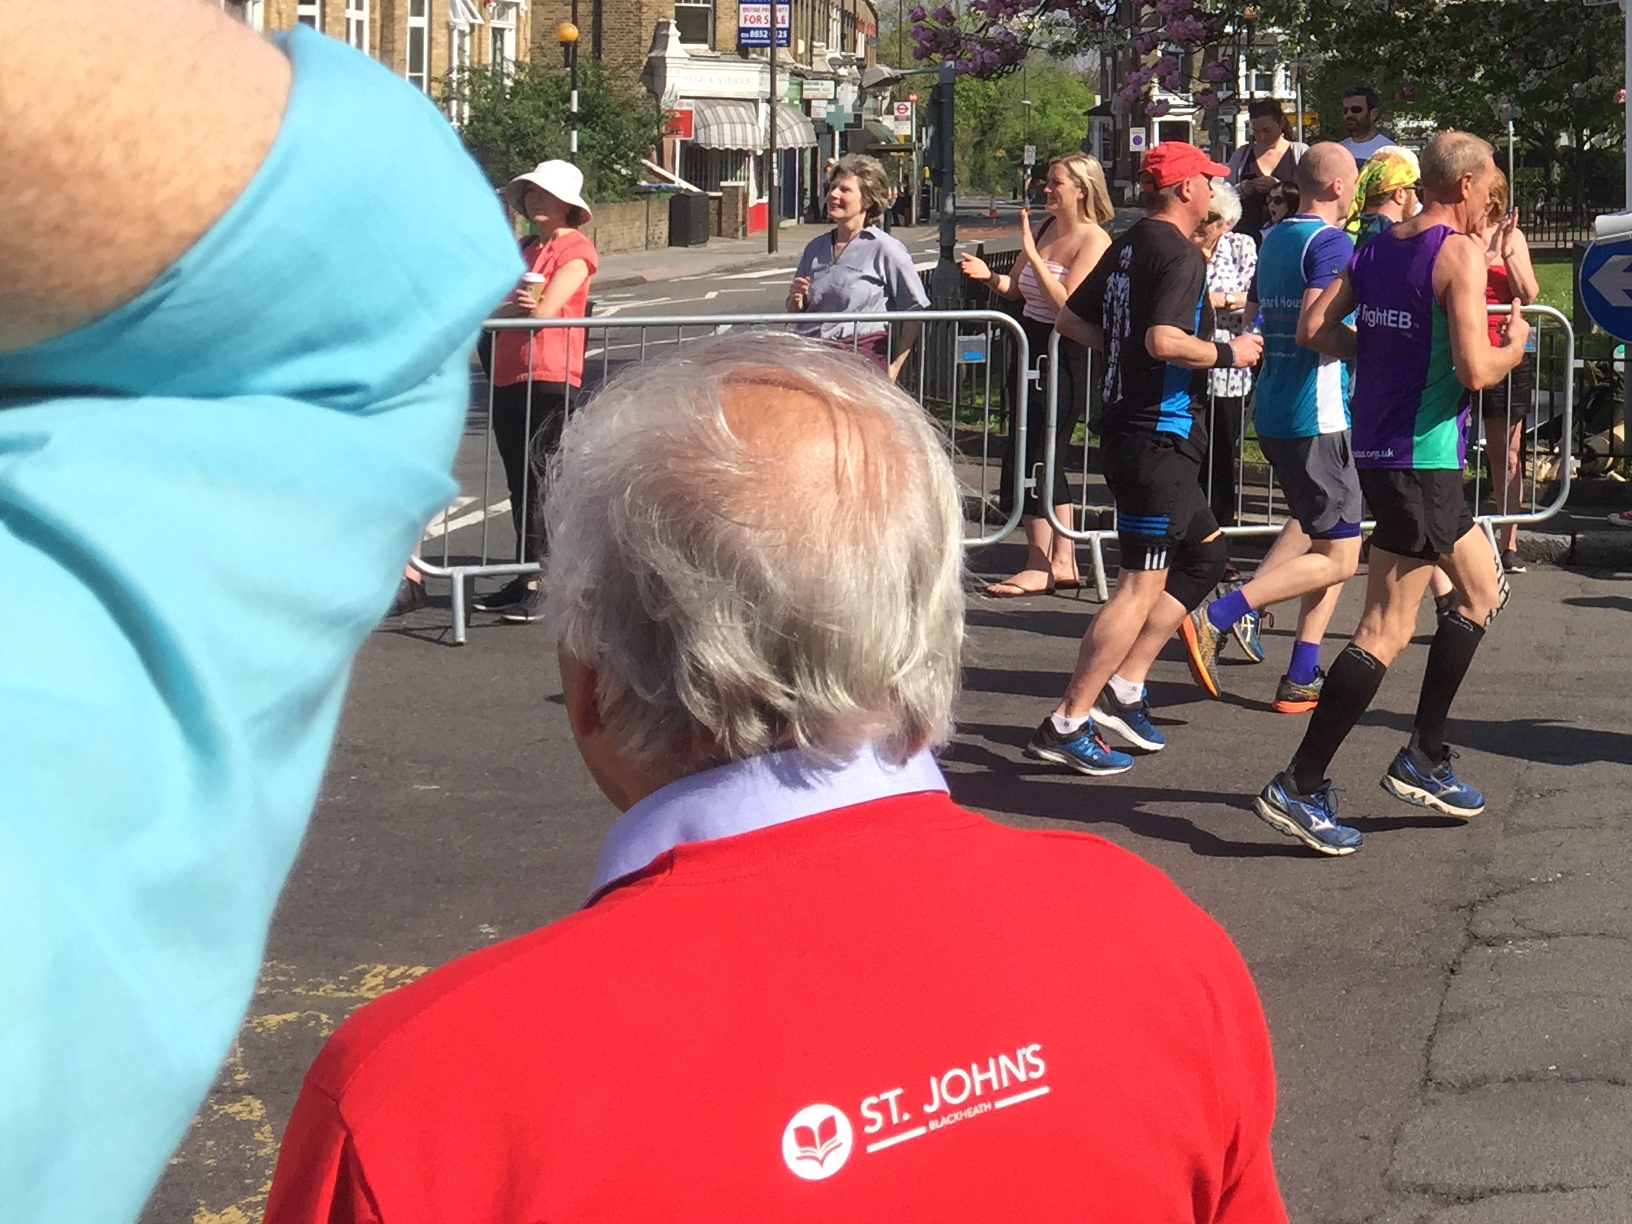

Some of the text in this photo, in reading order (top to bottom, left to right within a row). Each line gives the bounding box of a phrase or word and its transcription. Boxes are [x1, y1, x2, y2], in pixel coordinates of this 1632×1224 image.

[744, 15, 786, 25] FOR SLE
[1281, 296, 1307, 309] Hous
[859, 1087, 911, 1134] ST.
[927, 1100, 993, 1132] BLACKHEATH
